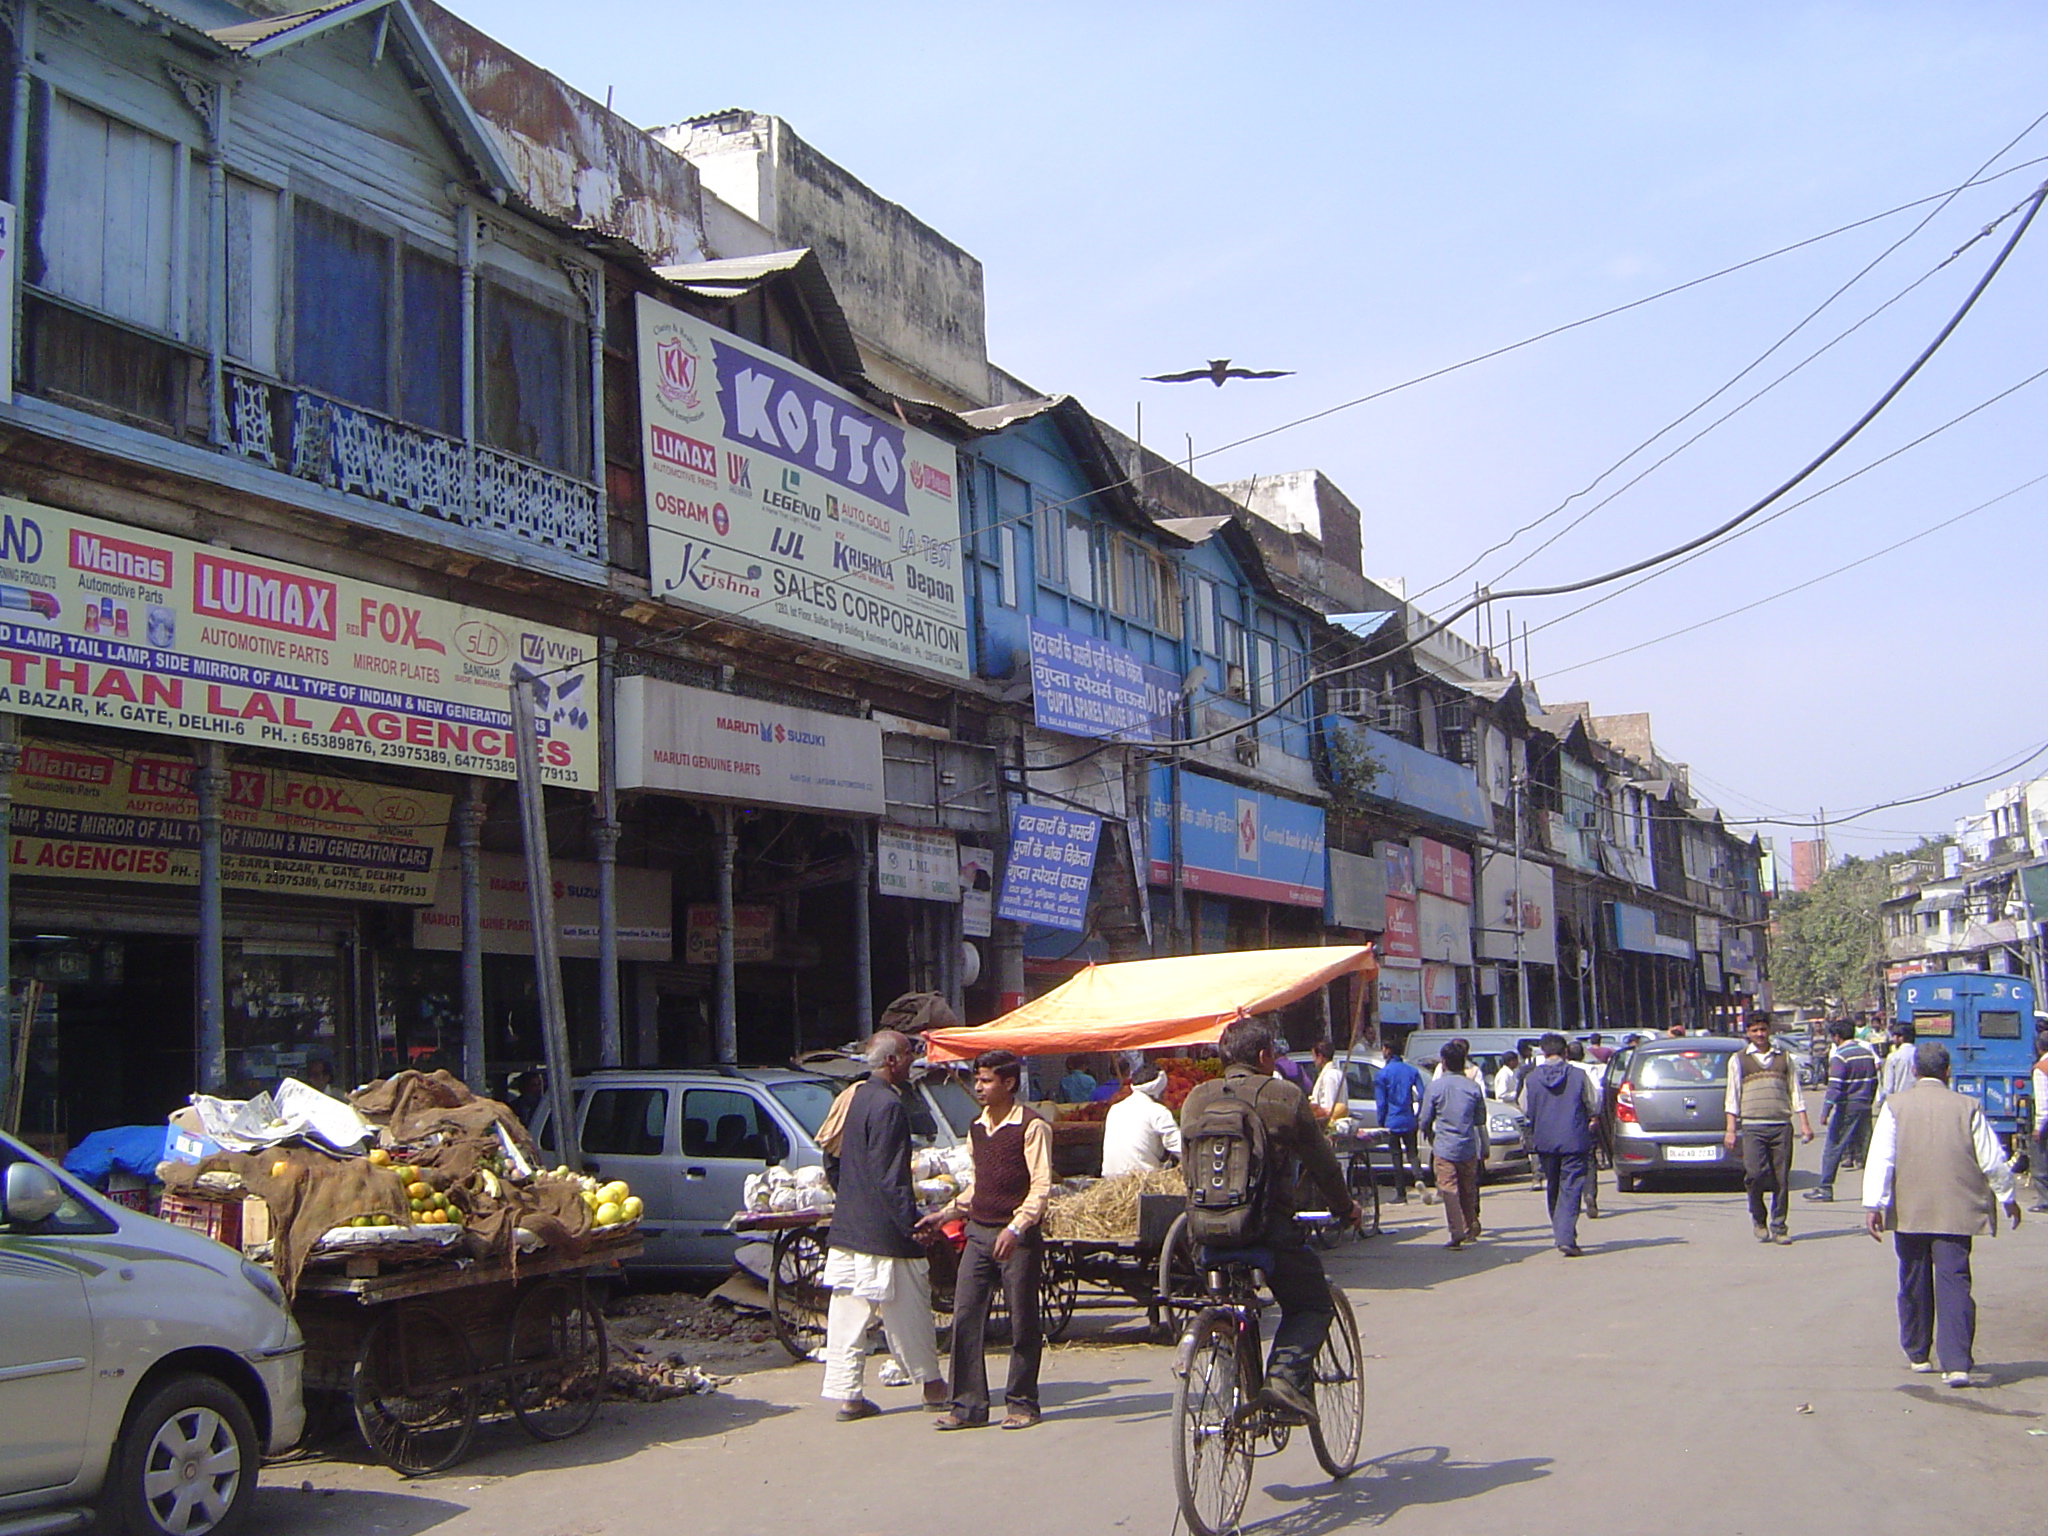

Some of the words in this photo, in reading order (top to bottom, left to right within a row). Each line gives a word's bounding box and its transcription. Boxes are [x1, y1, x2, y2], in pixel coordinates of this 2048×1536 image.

[665, 349, 690, 389] KK
[735, 368, 899, 495] KOITO
[653, 431, 715, 472] LUMAX
[656, 492, 709, 524] OSRAM
[763, 489, 821, 522] LEGEND
[841, 503, 865, 523] AUTO
[866, 514, 890, 534] GOLD
[0, 515, 42, 564] ND
[770, 527, 804, 561] IJL
[77, 535, 165, 582] Manas
[666, 542, 760, 598] Krishna
[833, 541, 894, 582] KRISHNA
[20, 569, 56, 589] PRODUCTS
[78, 574, 136, 599] Automotive
[138, 587, 163, 604] Parts
[202, 565, 330, 631] LUMAX
[773, 569, 838, 616] SALES
[843, 592, 960, 653] CORPORATION
[361, 597, 430, 648] FOX
[201, 627, 286, 658] AUTOMOTIVE
[289, 643, 330, 666] PARTS
[16, 628, 63, 654] LAMP,
[68, 637, 103, 658] TAIL
[107, 645, 151, 669] LAMP,
[156, 653, 190, 672] SIDE
[193, 660, 250, 682] MIRROR
[253, 670, 271, 684] OF
[274, 674, 299, 691] ALL
[303, 680, 337, 698] TYPE
[340, 686, 356, 700] OF
[360, 689, 401, 708] INDIAN
[405, 697, 415, 709] &
[417, 700, 443, 716] NEW
[354, 653, 397, 675] MIRROR
[401, 663, 440, 684] PLATES
[463, 663, 500, 680] SANDHAR
[1034, 665, 1070, 688] गुप्ता
[207, 685, 313, 729] LAL
[1047, 690, 1075, 717] GUPTA
[1075, 696, 1103, 723] SPARES
[19, 690, 89, 717] BAZAR,
[96, 703, 114, 717] K.
[120, 706, 173, 729] GATE,
[179, 714, 245, 736] DELHI-6
[302, 731, 376, 756] 65389876,
[381, 743, 450, 767] 23975389,
[716, 717, 759, 735] MARUTI
[787, 730, 826, 747] SUZUKI
[27, 752, 106, 781] Manas
[654, 750, 690, 767] MARUTI
[692, 755, 732, 772] GENUINE
[734, 760, 761, 776] PARTS
[78, 785, 100, 797] Parts
[127, 800, 199, 816] AUTOMOTI
[44, 812, 78, 833] SIDE
[80, 815, 133, 838] MIRROR
[138, 821, 156, 839] OF
[158, 821, 182, 842] ALL
[188, 826, 200, 842] TY
[222, 829, 235, 847] OF
[242, 830, 284, 851] INDIAN
[287, 837, 296, 851] &
[299, 839, 326, 855] NEW
[327, 841, 398, 863] GENERATION
[400, 849, 427, 866] CARS
[1057, 818, 1068, 836] के
[36, 843, 169, 874] AGENCIES
[1032, 838, 1043, 858] के
[1007, 864, 1031, 883] गुप्ता
[568, 885, 600, 898] SUZU
[507, 920, 534, 931] PART
